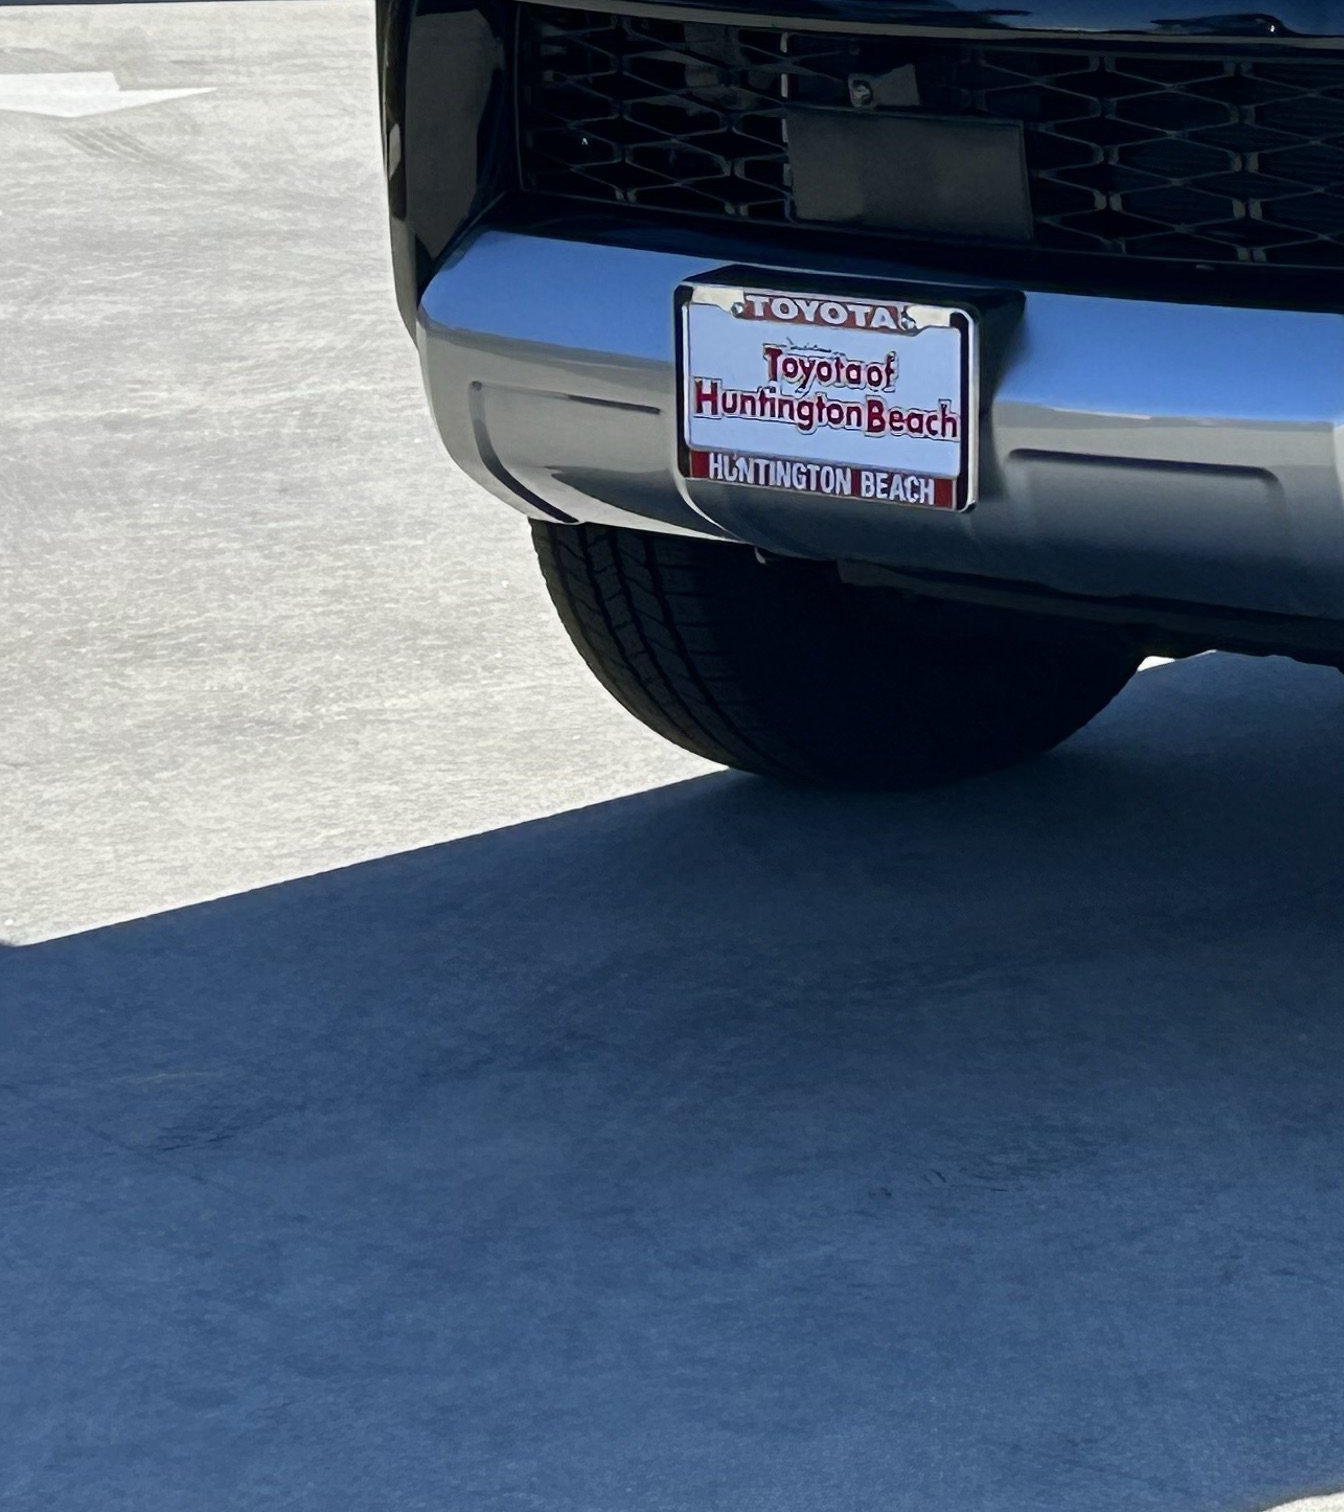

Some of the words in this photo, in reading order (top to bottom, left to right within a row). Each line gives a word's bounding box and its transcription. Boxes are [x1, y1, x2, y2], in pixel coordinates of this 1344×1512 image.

[746, 295, 899, 330] TOYOTA
[763, 345, 862, 397] Toyota
[865, 351, 897, 391] of
[694, 378, 862, 434] Huntington
[866, 398, 958, 439] Beach
[708, 452, 852, 496] HUNTINGTON
[860, 471, 936, 506] BEACH
